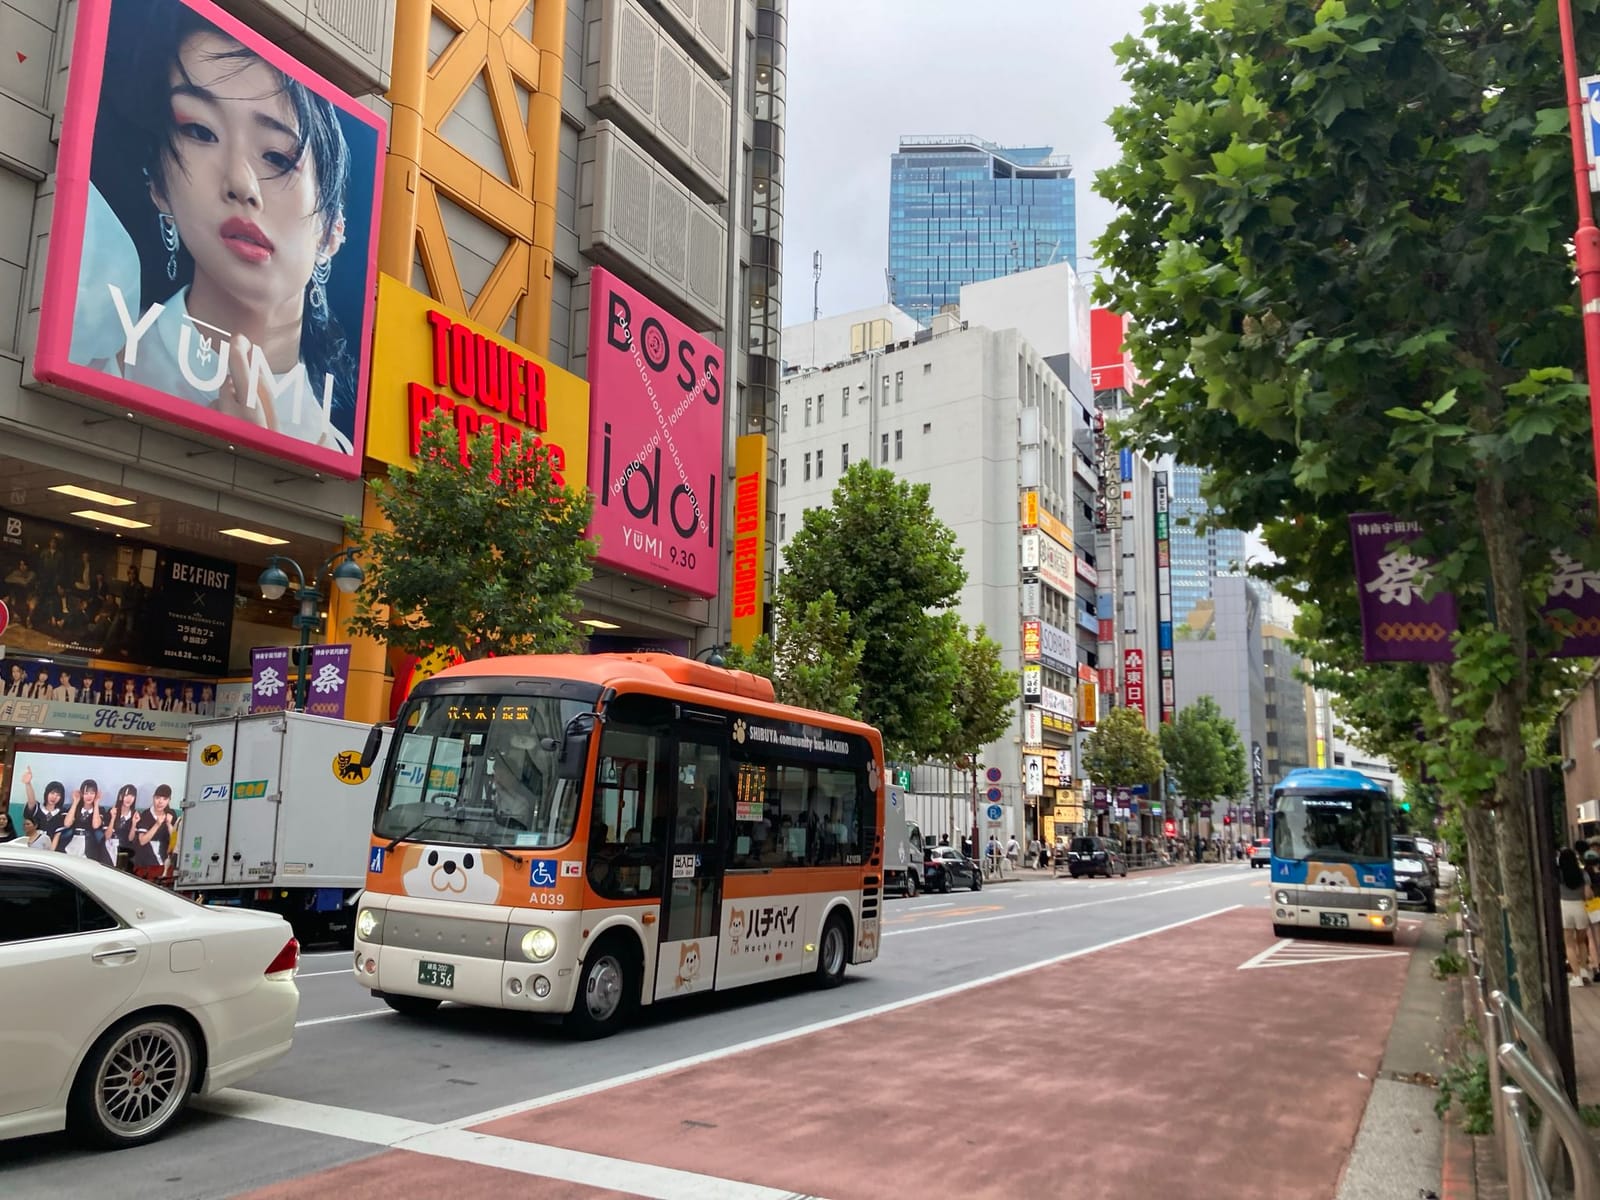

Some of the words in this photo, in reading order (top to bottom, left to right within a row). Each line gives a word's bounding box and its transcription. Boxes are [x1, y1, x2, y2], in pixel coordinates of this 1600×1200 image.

[607, 289, 721, 406] BOSS
[427, 309, 548, 433] TOWER
[601, 421, 716, 549] idol
[736, 471, 760, 535] TOWER
[1357, 520, 1424, 536] 神南宇田川
[669, 546, 696, 570] 9.30
[733, 536, 758, 619] RECORDS
[1364, 548, 1434, 606] 祭
[254, 666, 285, 696] 祭
[312, 663, 345, 694] 祭
[94, 708, 157, 732] Hi-Five
[749, 726, 778, 744] SHIBUYA
[779, 734, 813, 752] community
[203, 785, 228, 800] クール
[675, 856, 694, 868] 出入口
[529, 892, 565, 905] A039
[746, 905, 799, 939] ハチペイ
